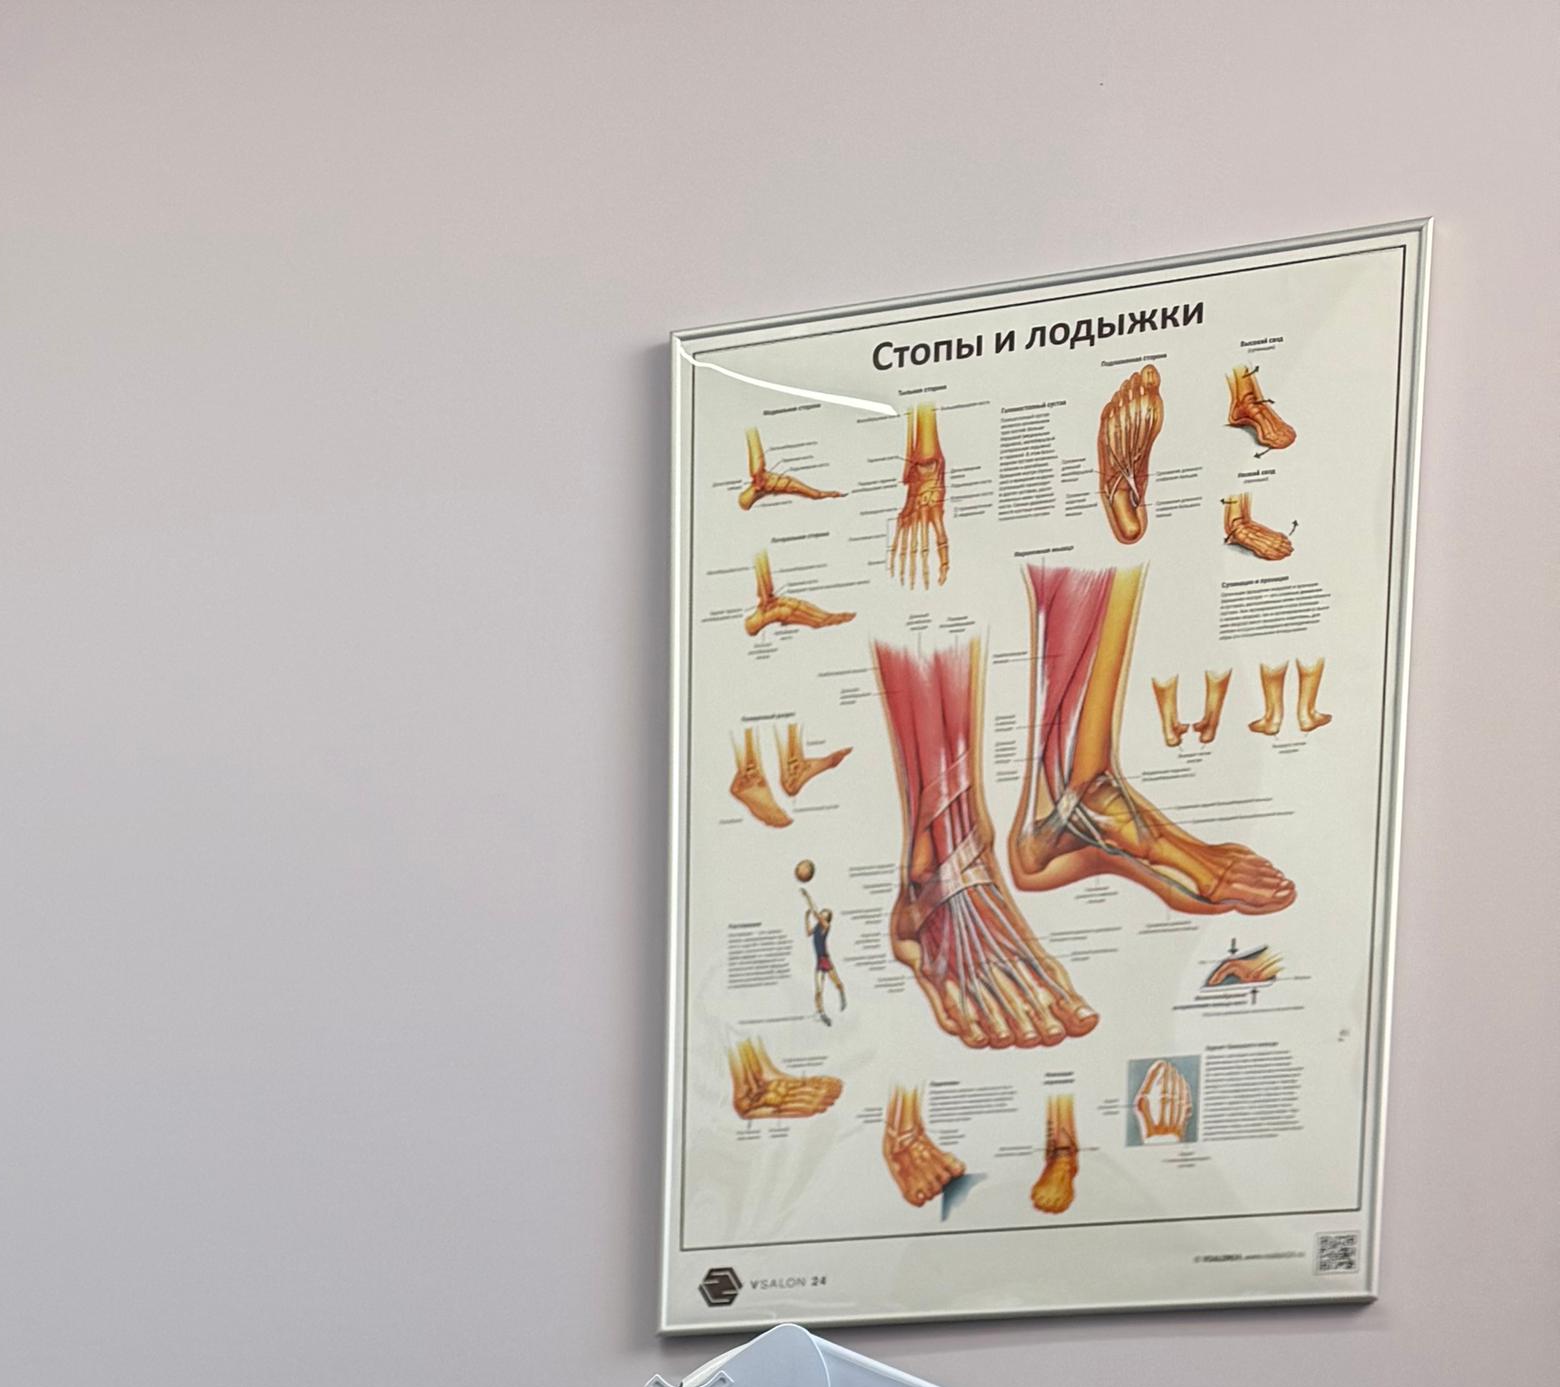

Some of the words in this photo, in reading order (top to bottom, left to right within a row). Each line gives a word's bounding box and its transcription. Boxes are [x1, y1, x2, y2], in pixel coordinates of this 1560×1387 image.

[872, 334, 983, 372] Стопы
[995, 330, 1015, 354] и
[1025, 301, 1205, 350] лодыжки
[750, 1277, 807, 1290] VSALON
[811, 1276, 827, 1287] 24
